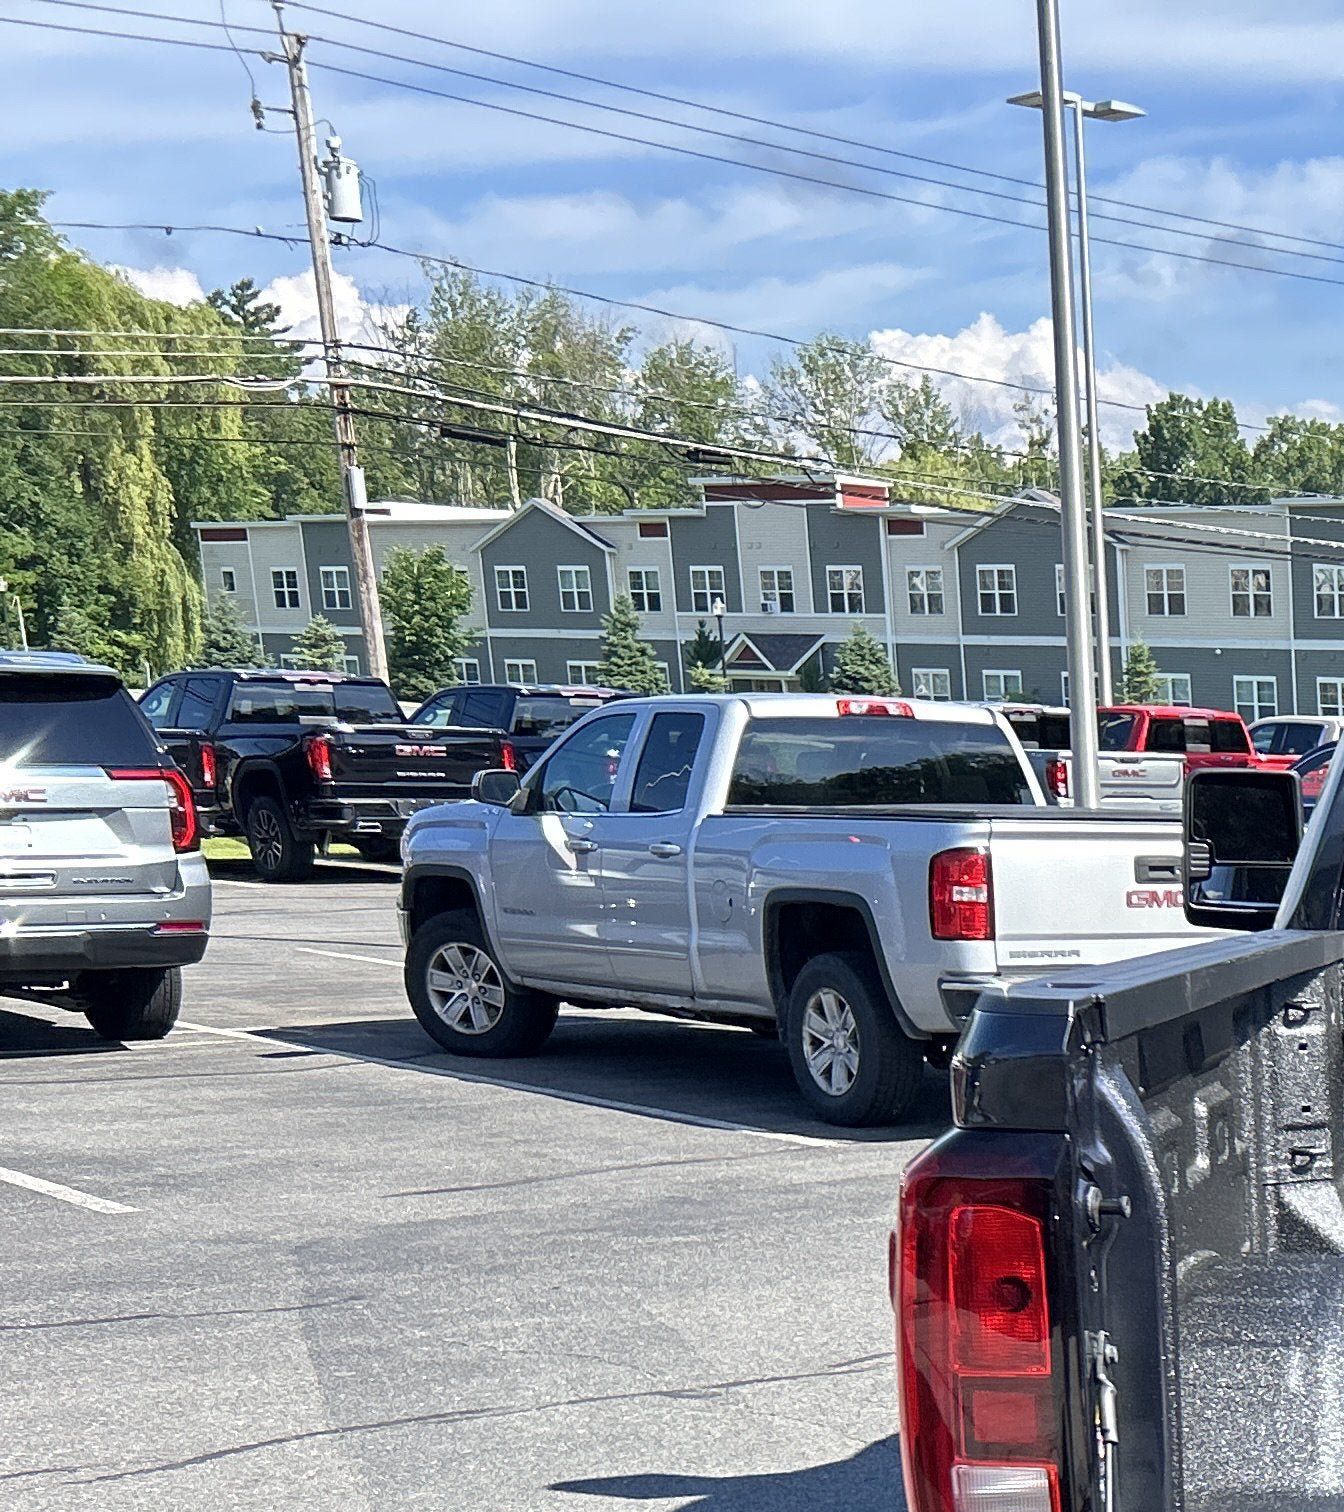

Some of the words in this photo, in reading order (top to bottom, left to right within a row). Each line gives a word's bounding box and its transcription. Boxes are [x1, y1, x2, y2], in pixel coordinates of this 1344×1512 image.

[394, 744, 448, 757] GMC
[0, 788, 48, 803] MC
[1008, 949, 1081, 959] SIERRA
